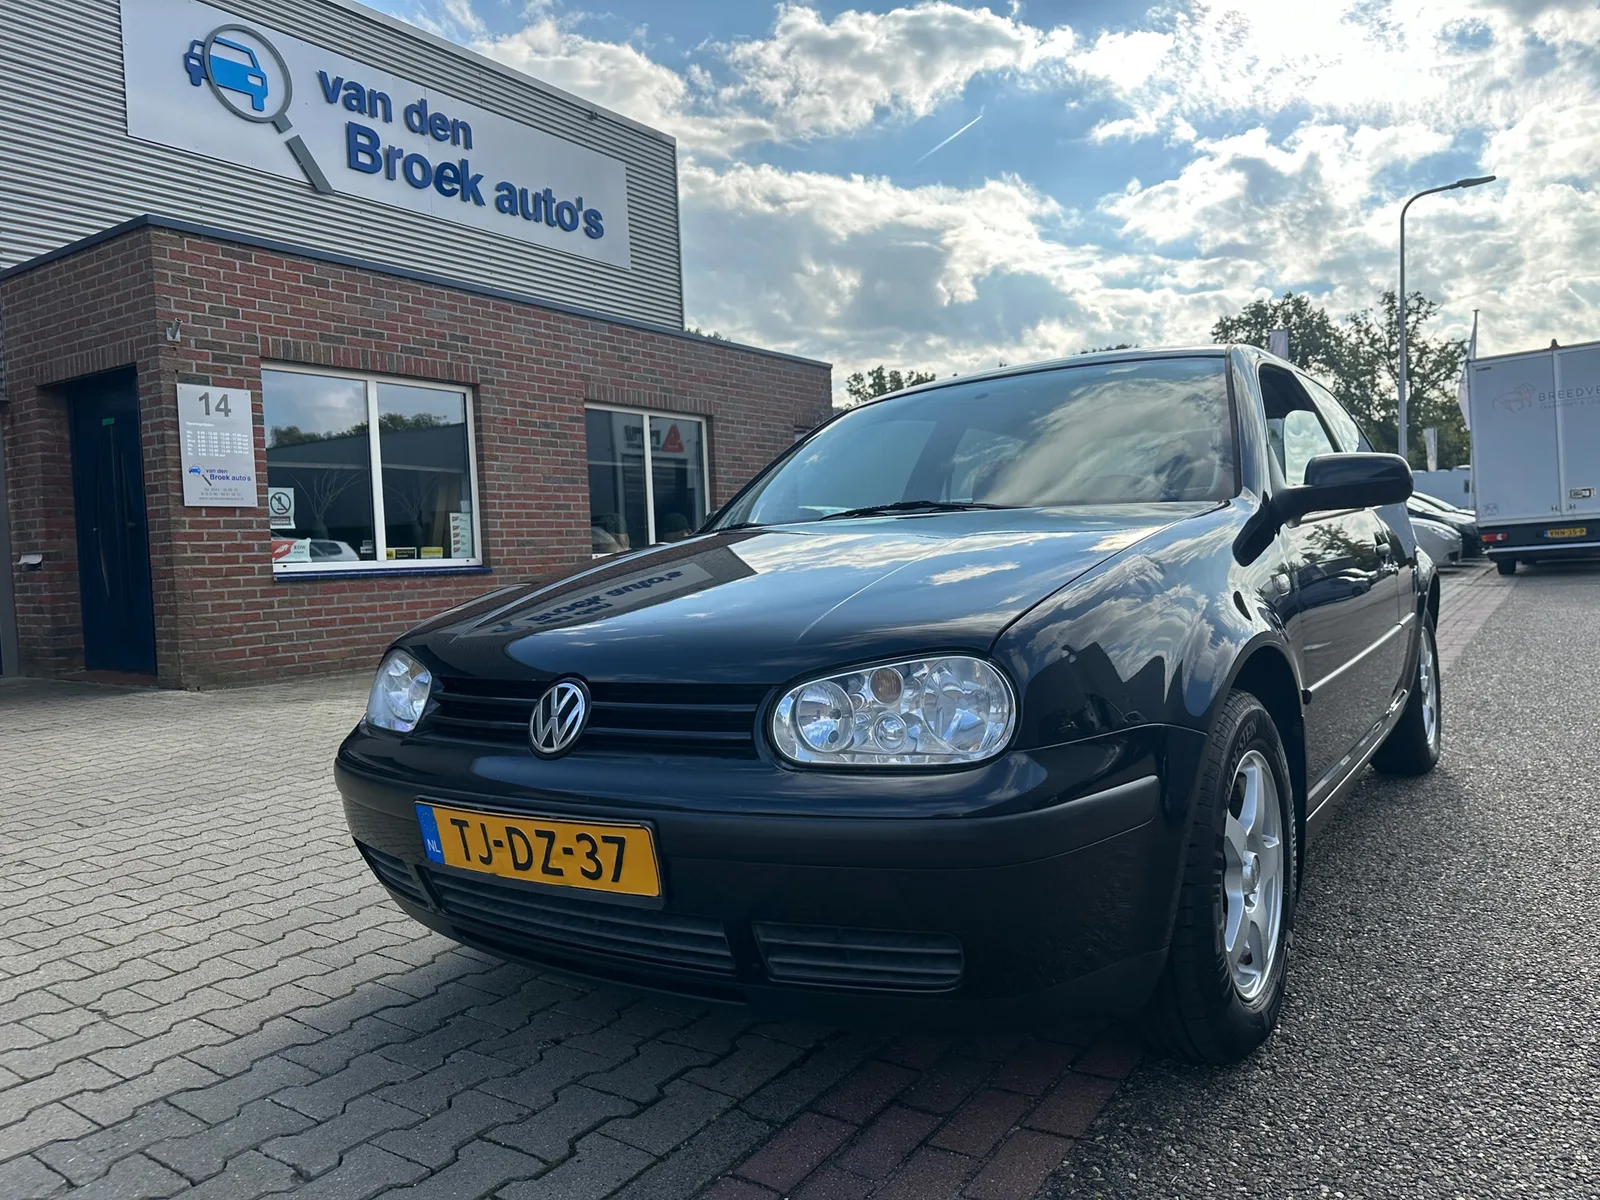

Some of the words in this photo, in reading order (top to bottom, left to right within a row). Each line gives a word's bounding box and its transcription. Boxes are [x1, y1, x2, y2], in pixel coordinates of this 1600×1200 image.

[316, 69, 393, 123] van
[404, 98, 473, 150] den
[346, 121, 487, 208] Broek
[495, 181, 605, 240] auto's
[199, 391, 232, 418] 14
[427, 838, 442, 854] NL
[449, 818, 627, 883] TJ-DZ-37
